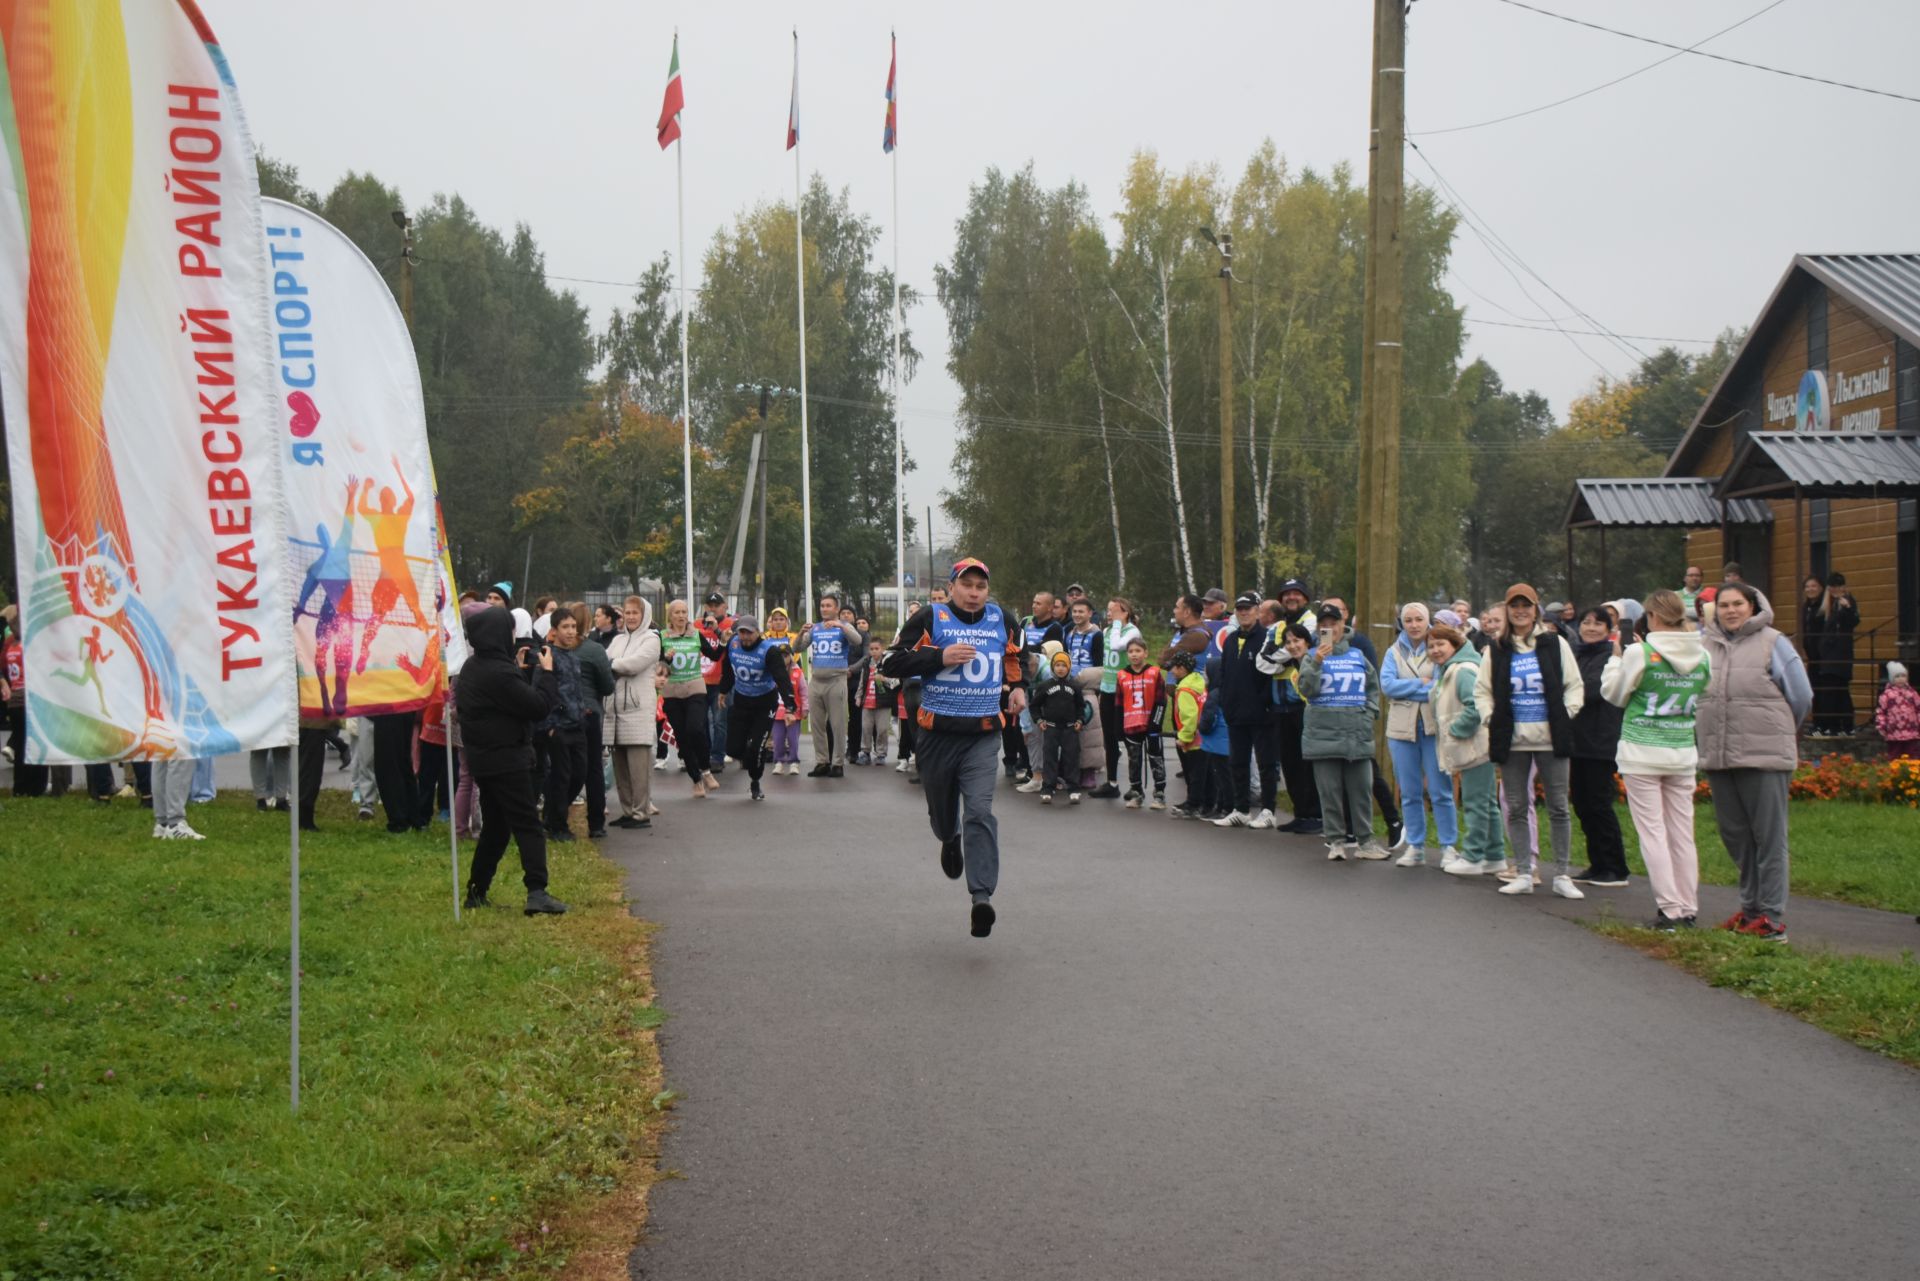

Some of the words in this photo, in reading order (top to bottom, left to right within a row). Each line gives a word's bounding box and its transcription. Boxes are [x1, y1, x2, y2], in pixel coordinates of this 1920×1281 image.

[164, 84, 222, 278] РАЙОН
[266, 226, 316, 388] СПОРТ!
[1833, 355, 1890, 405] Лыжный
[292, 442, 324, 467] Я
[179, 308, 263, 682] ТУКАЕВСКИЙ
[943, 629, 998, 639] ТУКАЕВСКИЙ
[956, 636, 988, 646] РАЙОН
[1320, 672, 1366, 694] 277
[1132, 691, 1144, 709] 3
